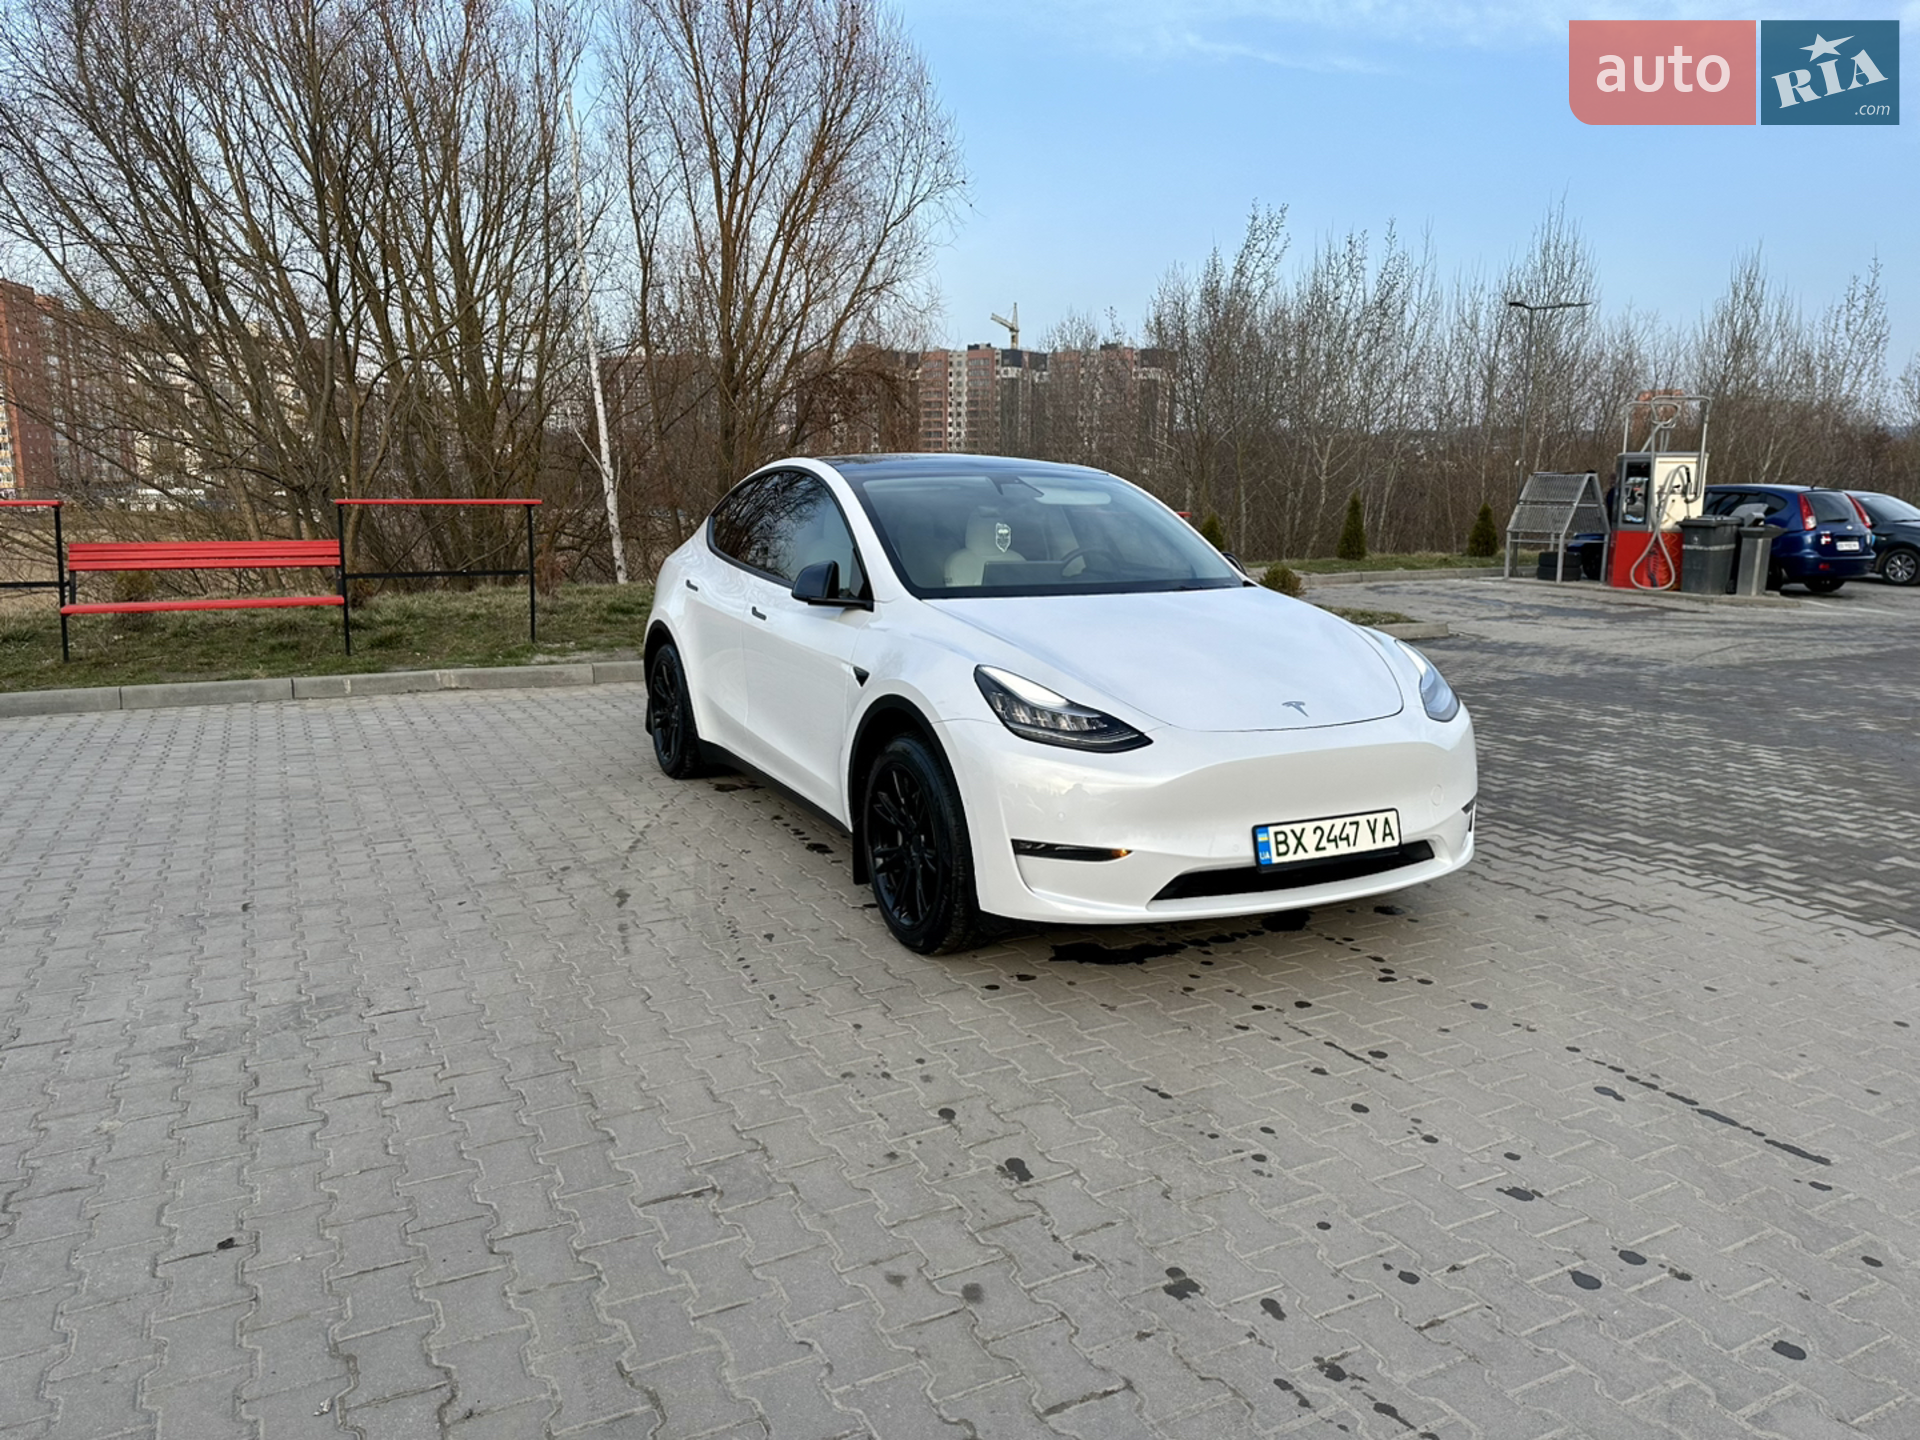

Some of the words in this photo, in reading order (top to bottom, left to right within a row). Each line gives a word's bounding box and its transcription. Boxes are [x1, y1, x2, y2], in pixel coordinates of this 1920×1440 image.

[1273, 828, 1308, 857] BX
[1313, 820, 1360, 852] 2447
[1366, 816, 1395, 844] YA
[1259, 851, 1271, 860] UA
